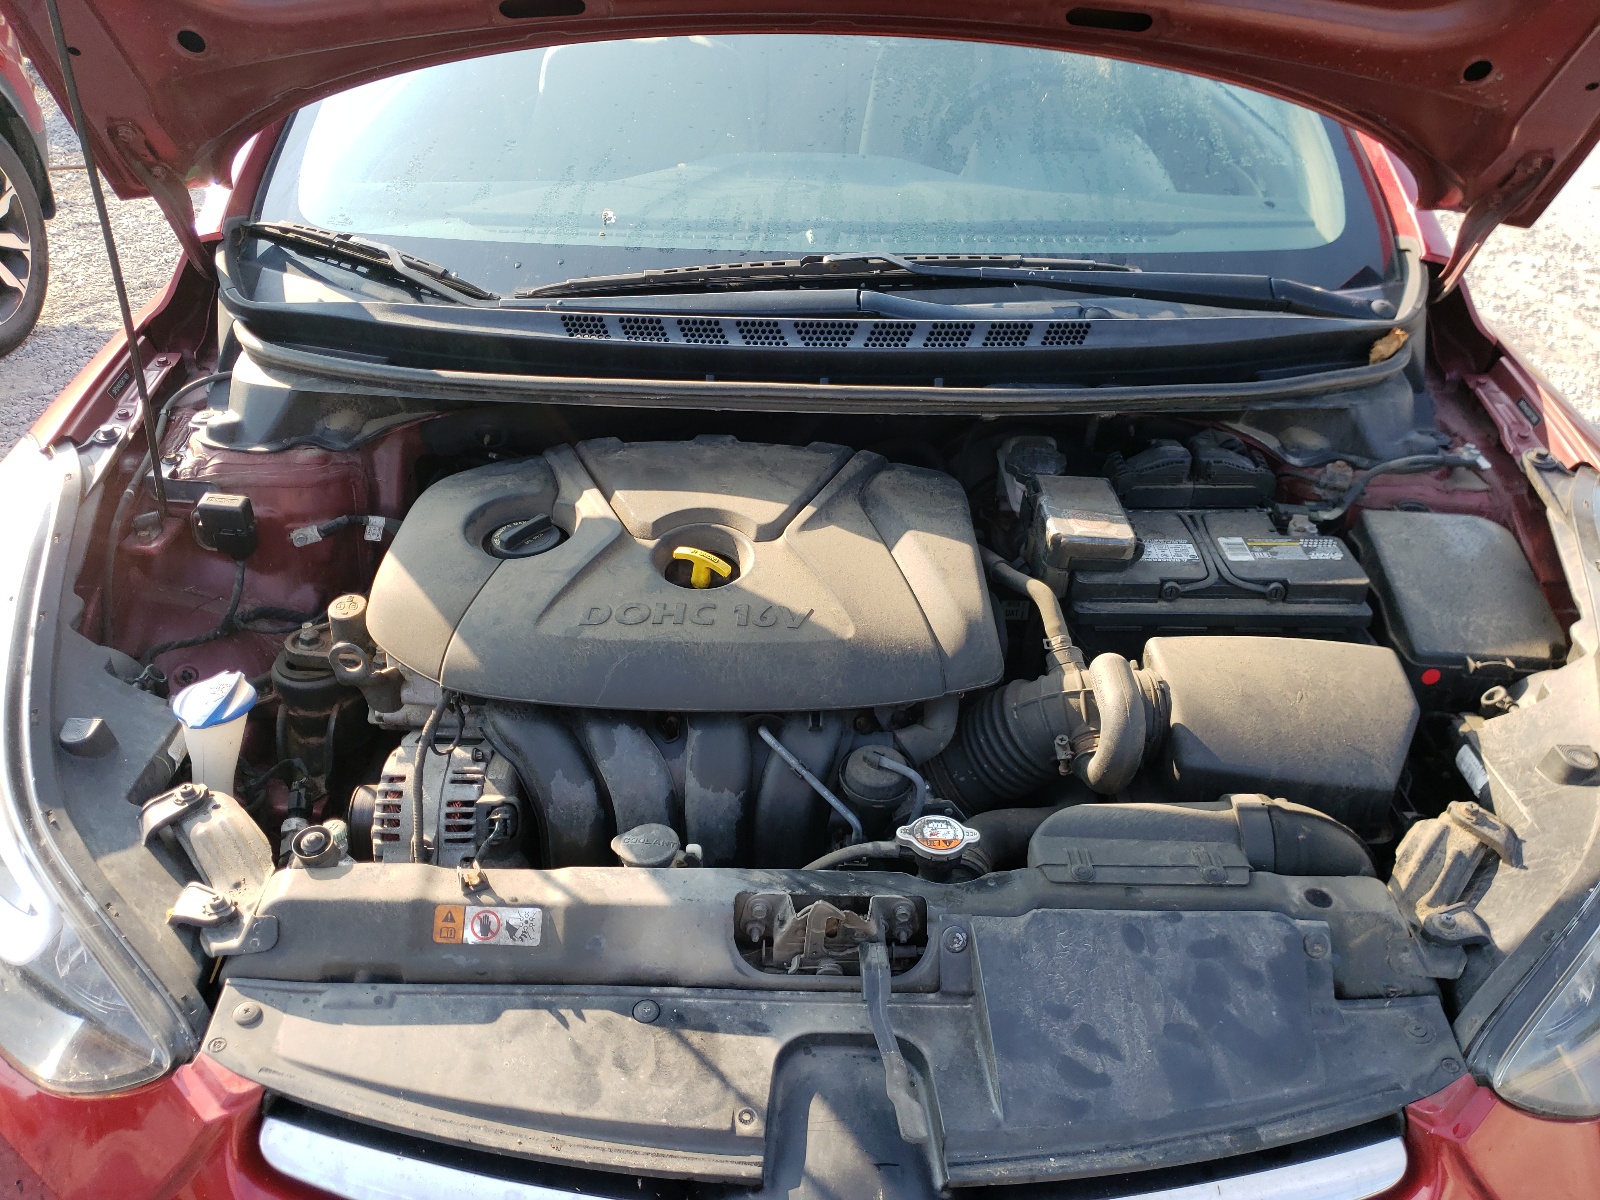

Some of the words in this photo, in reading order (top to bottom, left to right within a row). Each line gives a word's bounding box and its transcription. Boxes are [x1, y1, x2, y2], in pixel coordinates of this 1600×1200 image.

[578, 602, 718, 626] DOHC
[733, 603, 815, 629] 16V
[622, 837, 678, 849] COOLANT
